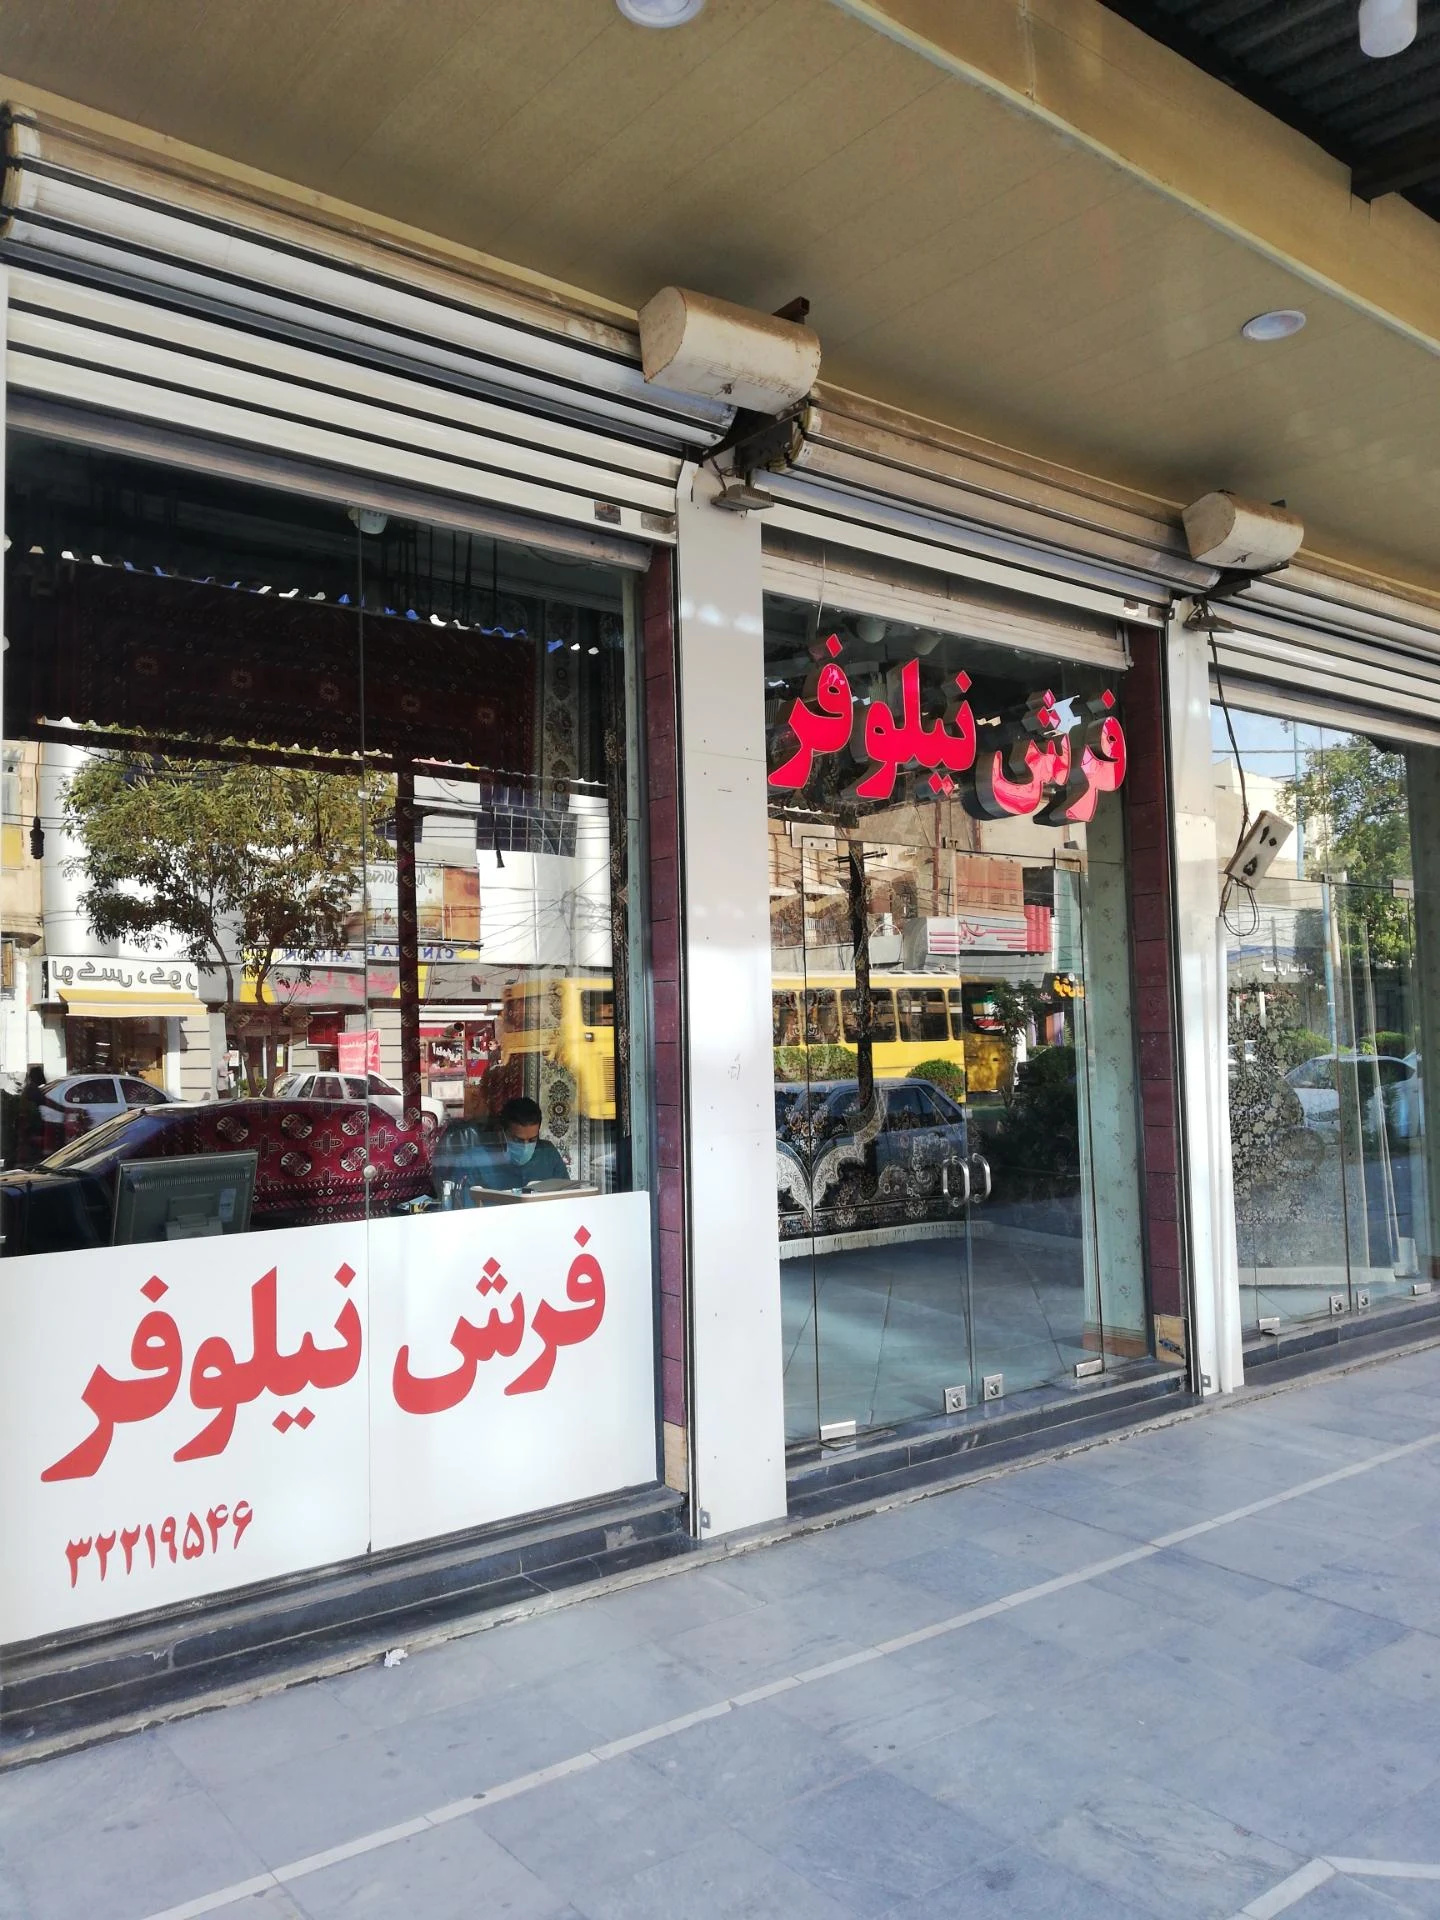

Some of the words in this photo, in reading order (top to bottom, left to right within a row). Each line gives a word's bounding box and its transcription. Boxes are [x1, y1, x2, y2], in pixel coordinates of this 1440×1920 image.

[768, 634, 977, 800] نیلوفر
[991, 688, 1127, 823] فرش
[41, 1262, 363, 1483] نیلوفر
[391, 1226, 607, 1416] فرش
[64, 1500, 253, 1590] ۳۲۲۱۹۵۴۶
